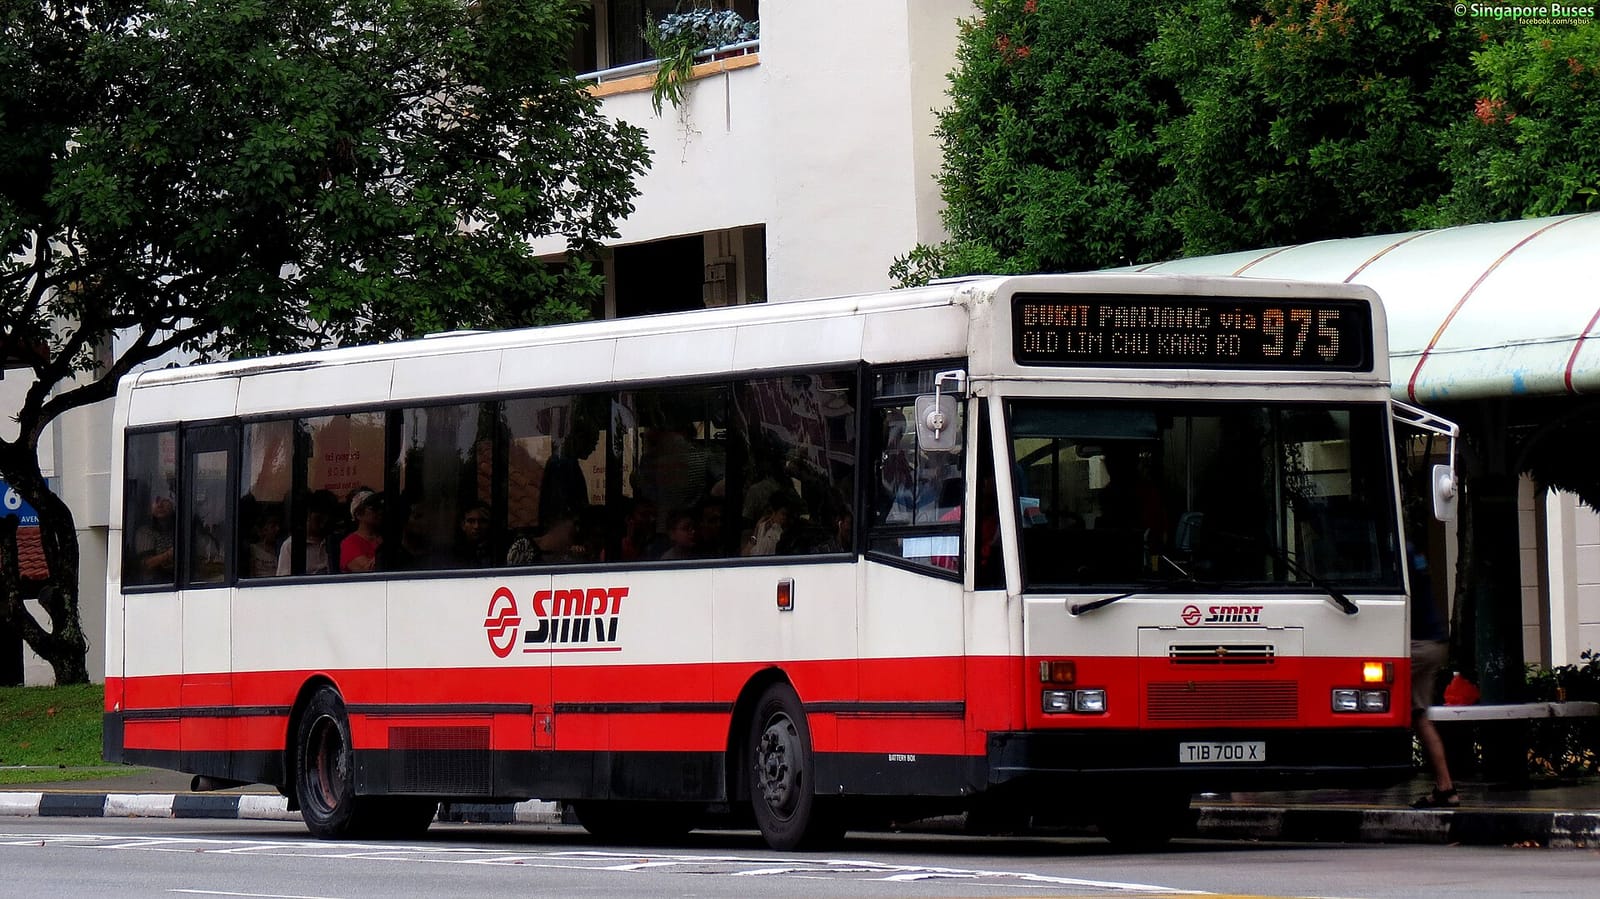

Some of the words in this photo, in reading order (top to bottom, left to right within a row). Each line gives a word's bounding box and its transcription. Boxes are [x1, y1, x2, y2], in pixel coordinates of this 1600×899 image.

[1024, 304, 1090, 326] BUKIT
[1099, 305, 1211, 329] PANJANG
[1219, 308, 1256, 329] via
[1023, 330, 1058, 353] OLD
[1067, 331, 1102, 354] LIM
[1111, 332, 1149, 354] CHU
[1158, 333, 1208, 355] KANG
[1217, 334, 1241, 356] RD
[1262, 308, 1340, 357] 975
[524, 587, 629, 643] SMRT
[1205, 606, 1263, 622] SMRT
[1187, 746, 1210, 760] TIB
[1214, 745, 1243, 760] 700
[1249, 745, 1257, 759] X
